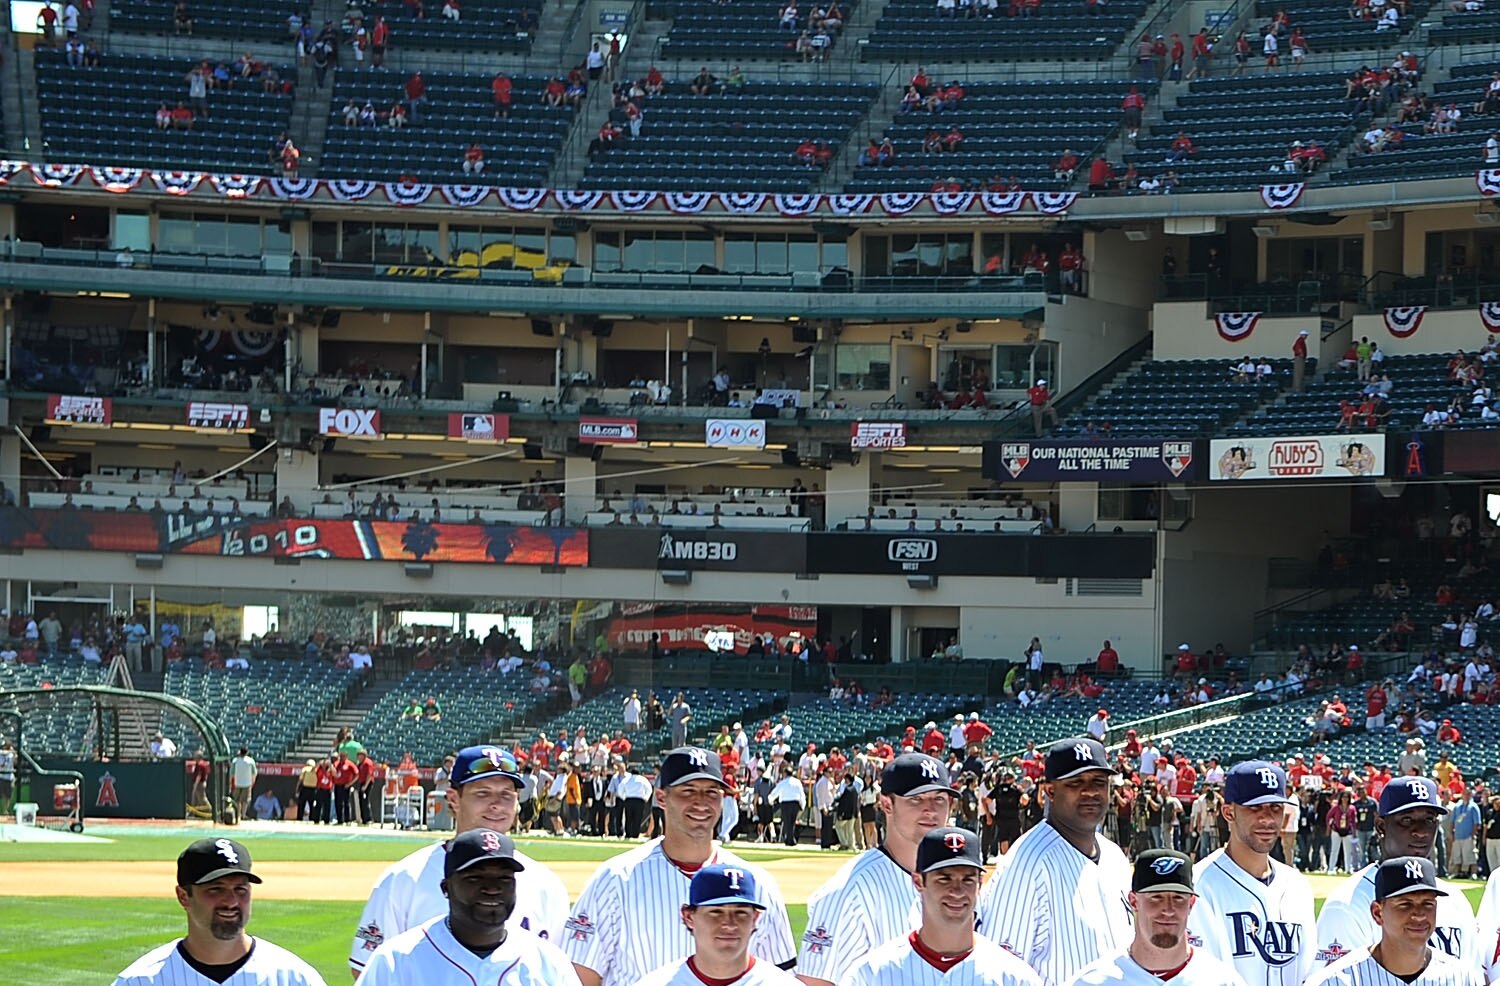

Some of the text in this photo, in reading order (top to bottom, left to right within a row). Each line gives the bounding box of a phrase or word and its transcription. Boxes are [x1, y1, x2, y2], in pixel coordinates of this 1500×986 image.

[59, 395, 103, 409] ESPN
[188, 402, 248, 421] ESPN
[189, 419, 245, 429] RADIO
[319, 407, 377, 436] FOX
[856, 422, 904, 437] ESPN
[582, 424, 621, 438] MLB.com
[851, 436, 906, 449] DEPORTES
[1031, 448, 1056, 461] OUR
[1057, 446, 1110, 460] NATIONAL
[1112, 446, 1160, 459] PASTIME
[1274, 445, 1320, 463] RUBY'S
[1057, 458, 1130, 470] ALL THE TIME
[895, 540, 930, 559] FSN
[902, 562, 919, 571] WEST
[689, 748, 709, 767] NY
[1073, 743, 1094, 761] NY
[920, 759, 940, 779] NY
[1403, 860, 1424, 880] NY
